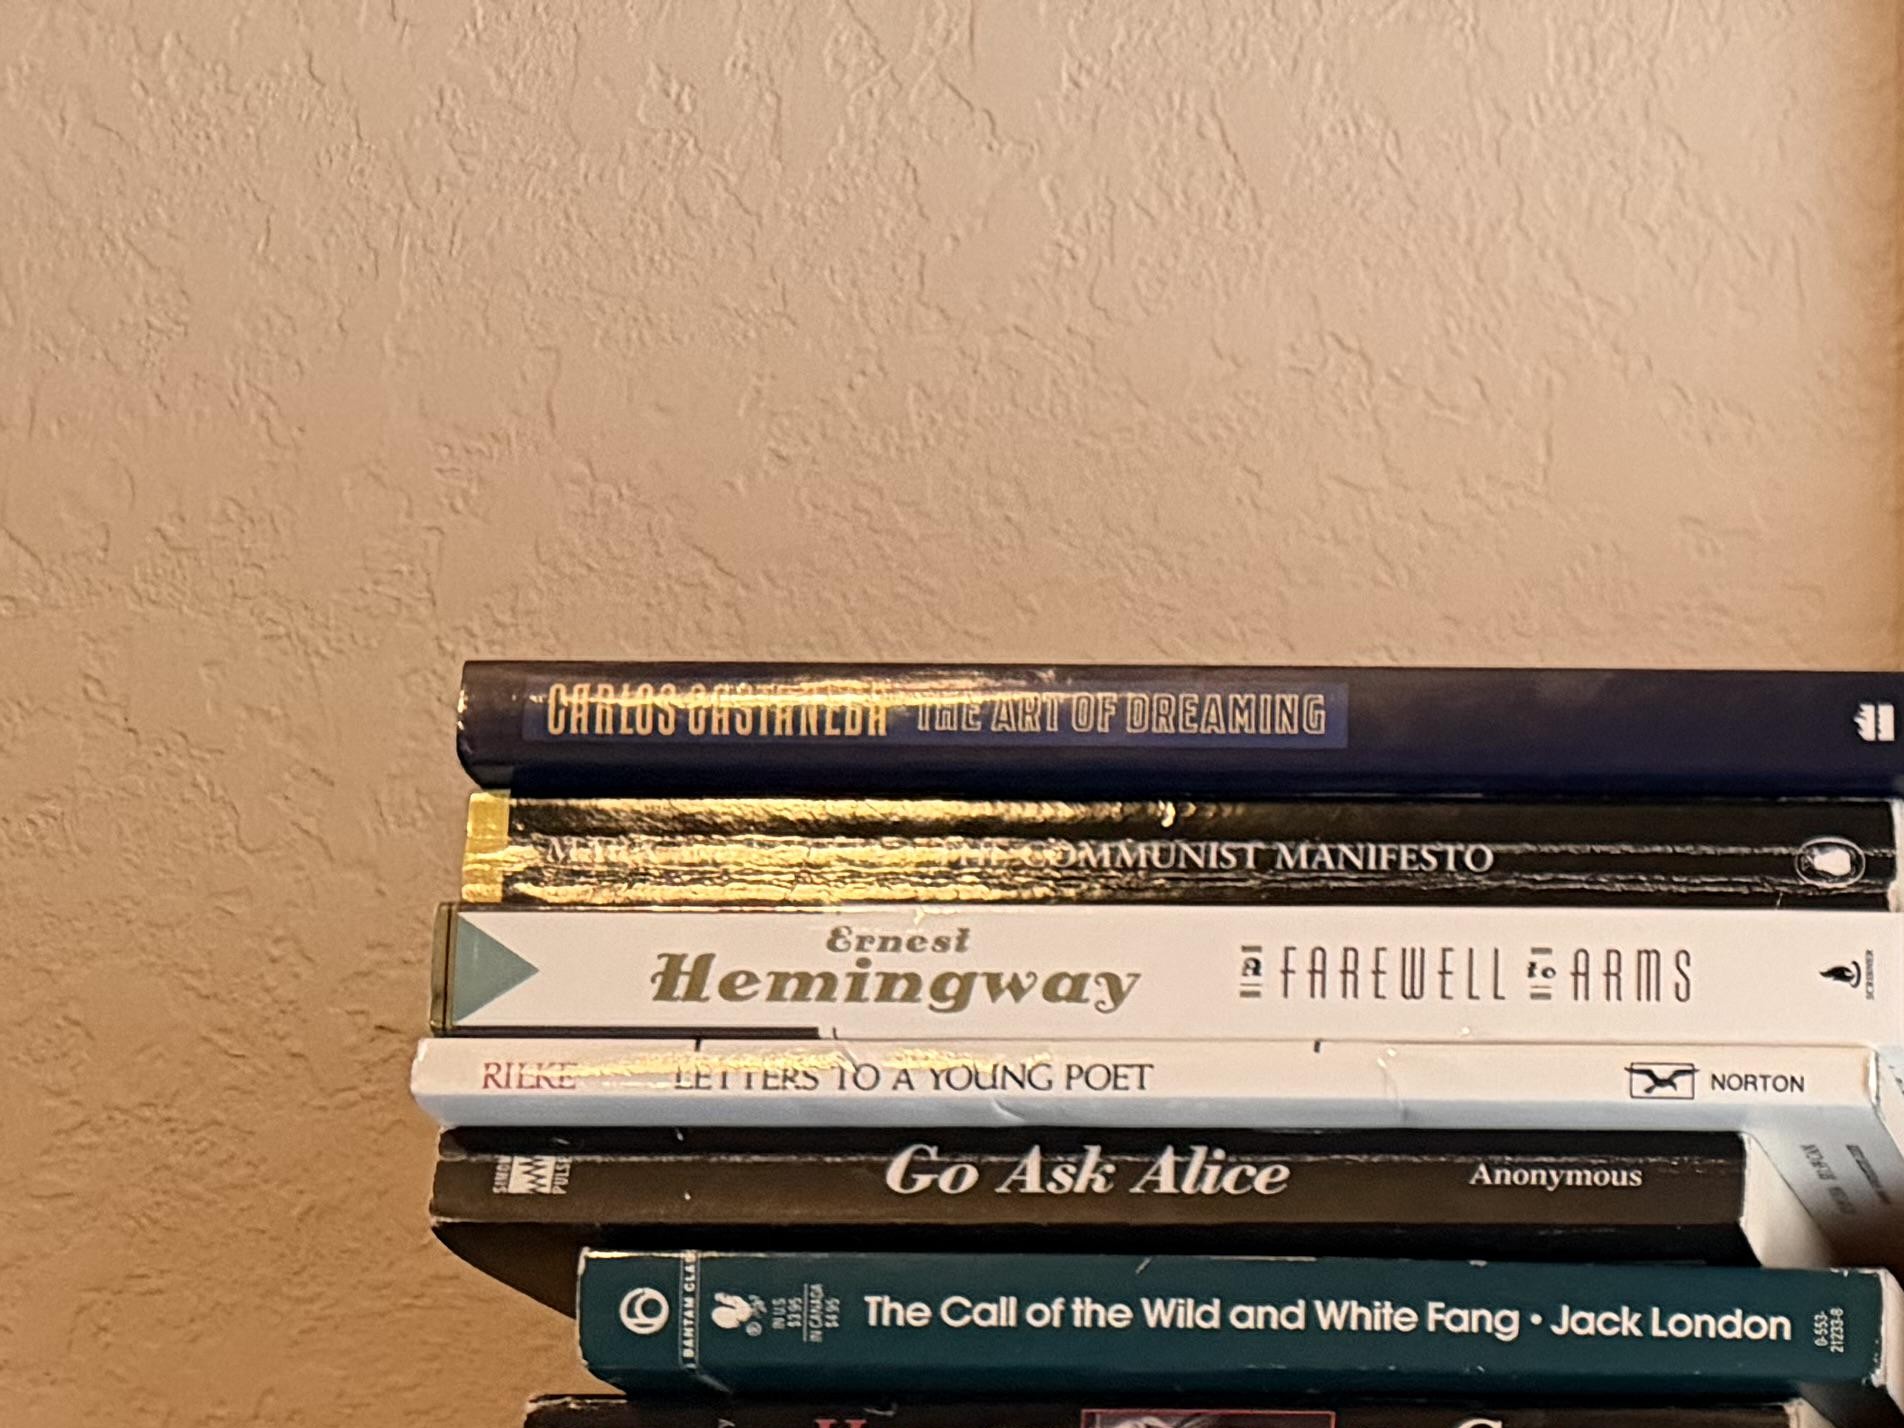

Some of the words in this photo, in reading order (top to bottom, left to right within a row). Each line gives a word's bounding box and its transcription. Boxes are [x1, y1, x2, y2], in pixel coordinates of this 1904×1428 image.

[825, 926, 970, 954] Ernest
[649, 952, 1141, 1012] Hemingway
[1710, 1073, 1805, 1094] NORTON
[1469, 1162, 1643, 1191] Anonymous
[865, 1295, 934, 1329] The
[941, 1296, 1016, 1329] Call
[1025, 1297, 1068, 1329] of
[1074, 1298, 1133, 1330] the
[1141, 1297, 1220, 1330] Wild
[1230, 1299, 1305, 1331] and
[1315, 1300, 1418, 1332] White
[1428, 1303, 1520, 1342] Fang
[1551, 1305, 1643, 1337] Jack
[1651, 1307, 1791, 1341] London
